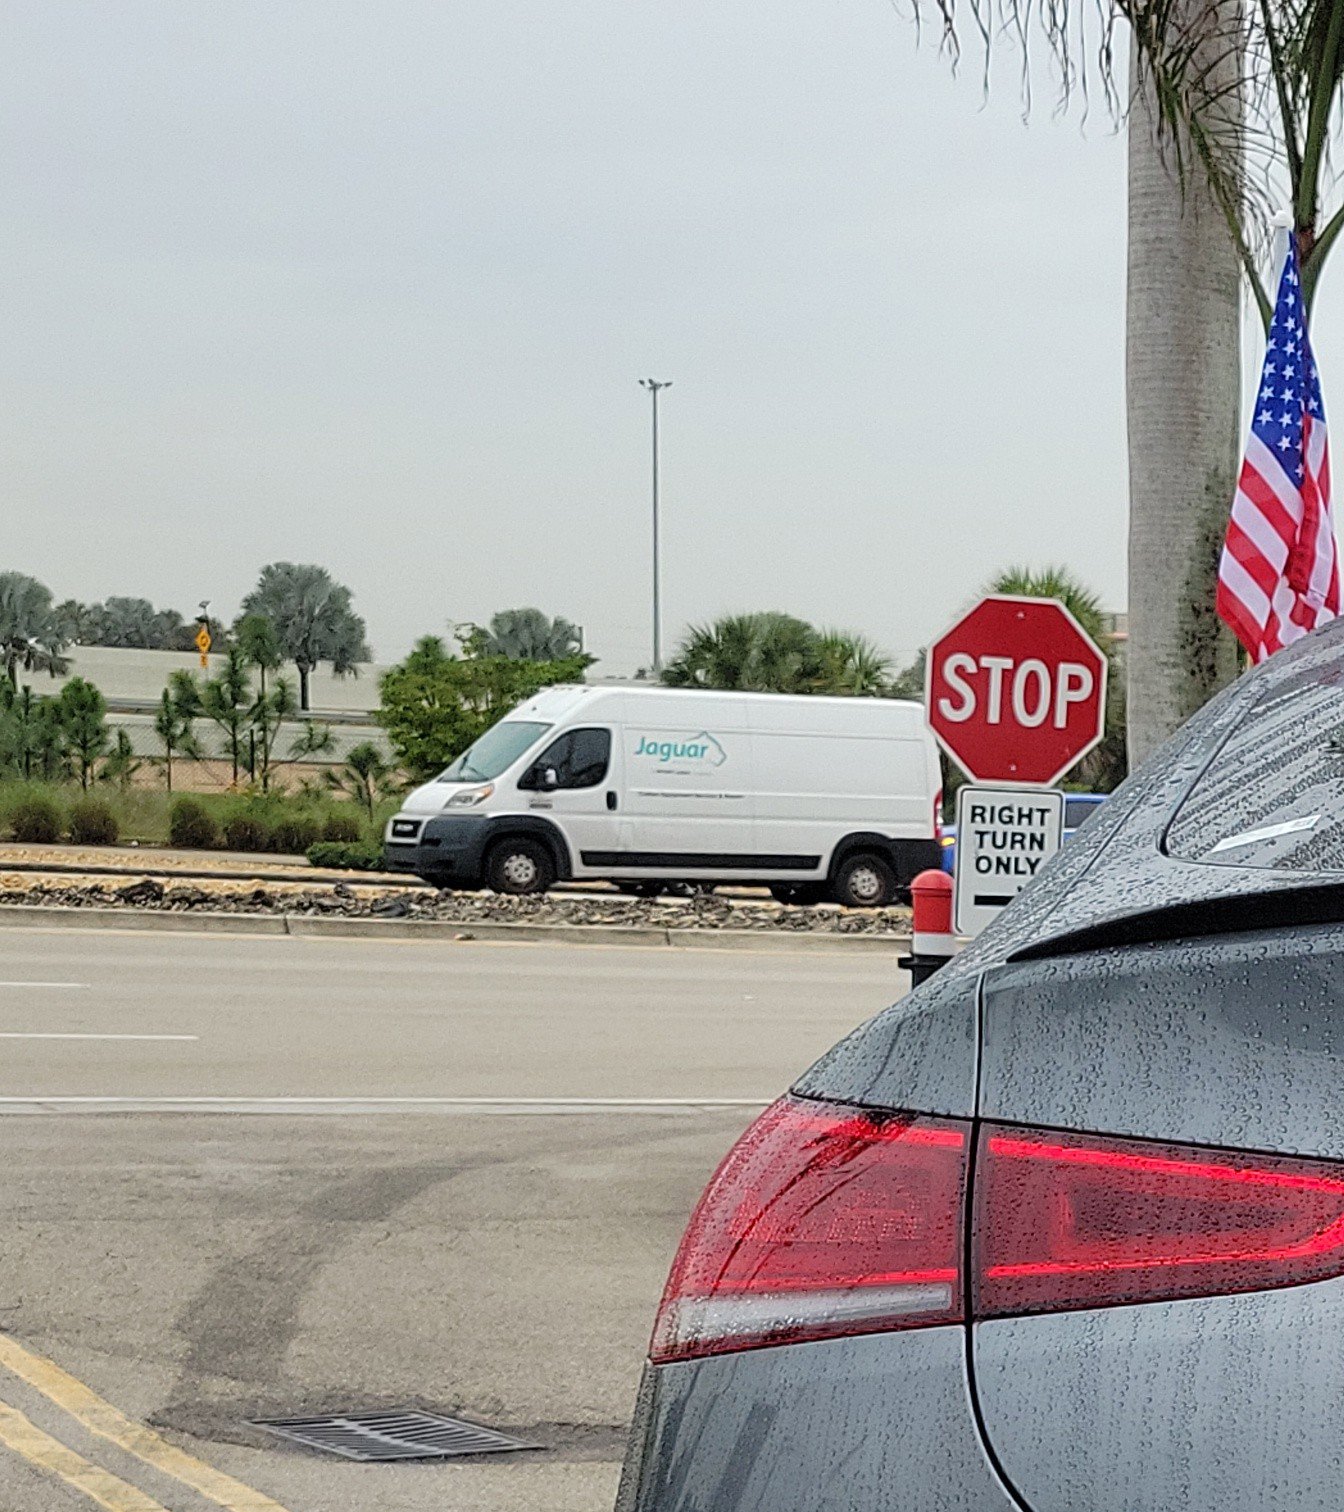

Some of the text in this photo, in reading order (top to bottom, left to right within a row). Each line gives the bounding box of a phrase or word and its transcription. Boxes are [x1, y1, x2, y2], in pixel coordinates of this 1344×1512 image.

[937, 652, 1094, 729] STOP
[634, 736, 708, 763] Jaguar
[970, 805, 1052, 827] RIGHT
[975, 830, 1045, 851] TURN
[974, 854, 1041, 876] ONLY
